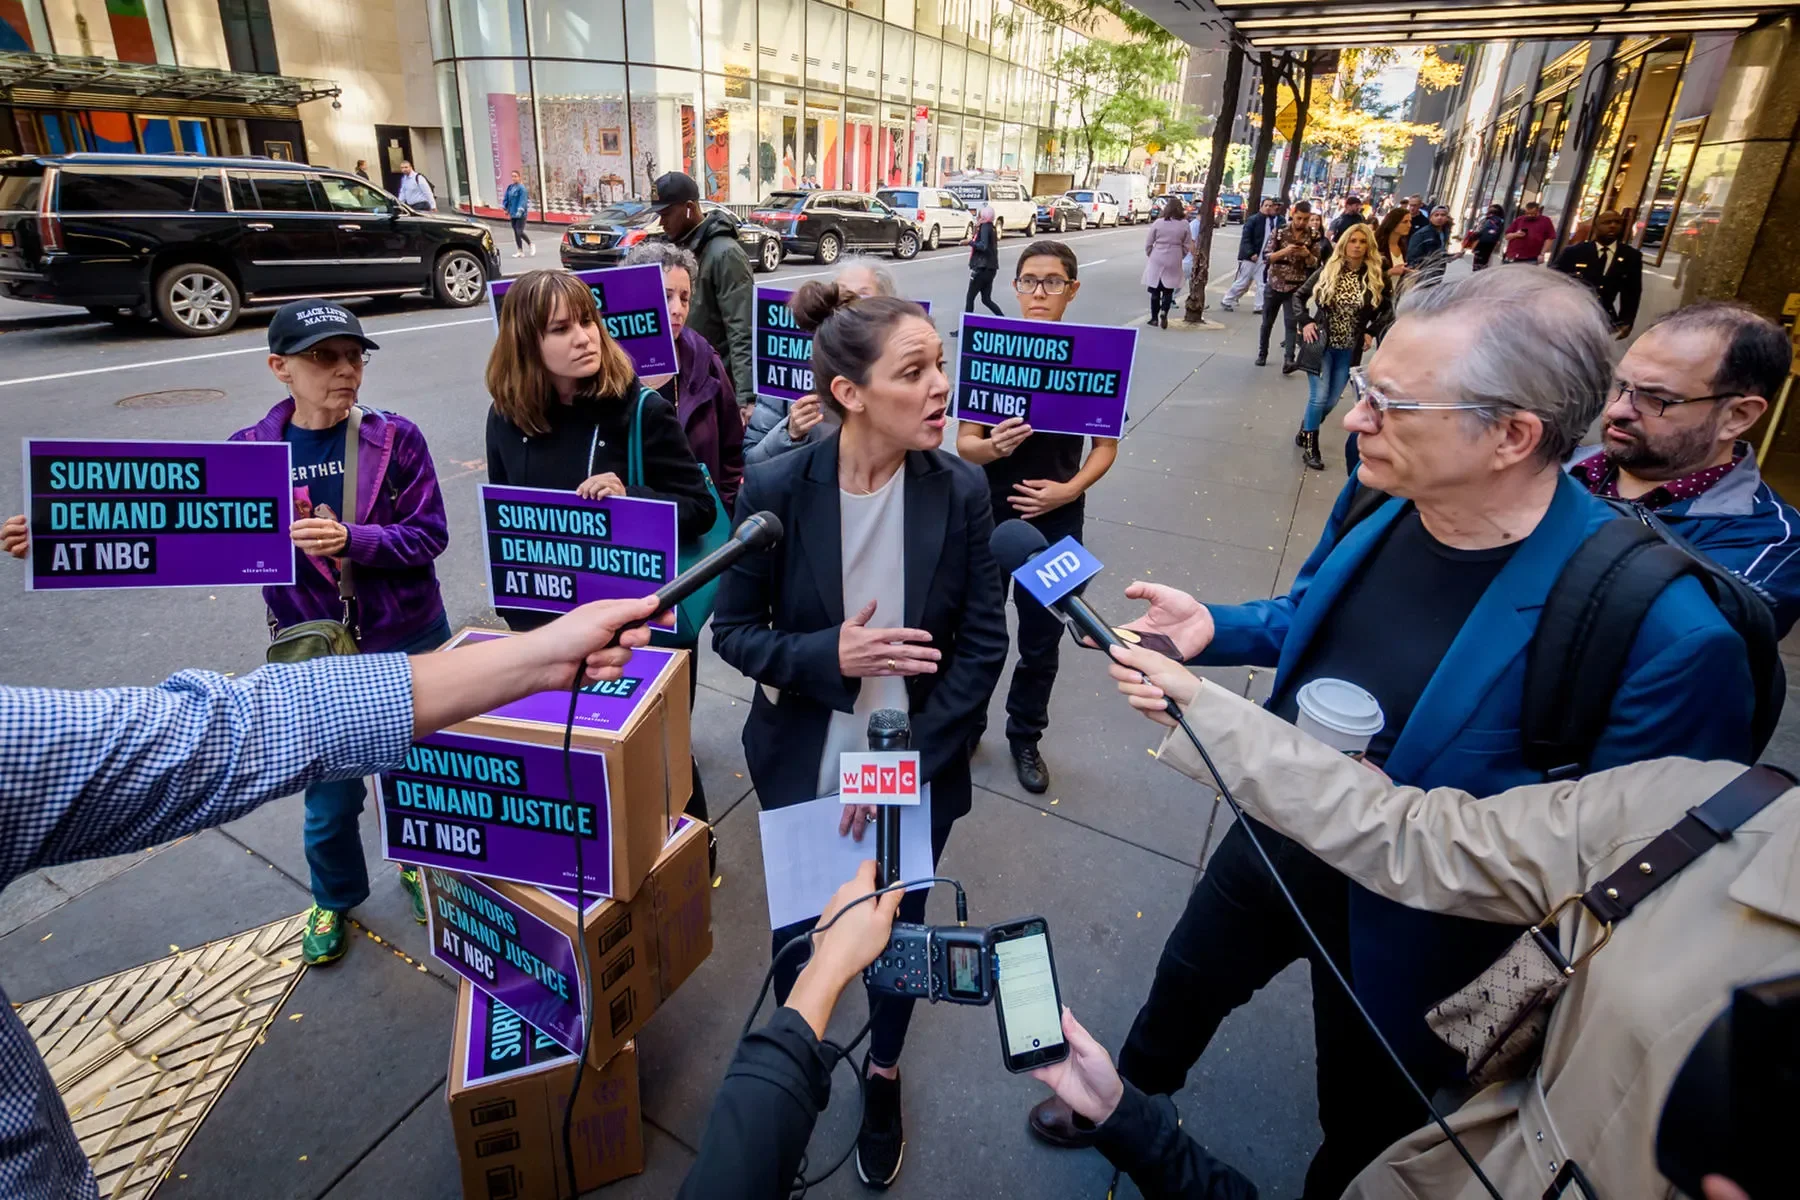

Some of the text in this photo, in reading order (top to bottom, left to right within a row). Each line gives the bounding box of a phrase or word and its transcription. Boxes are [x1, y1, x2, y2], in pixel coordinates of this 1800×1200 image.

[296, 307, 325, 321] BLACK
[303, 315, 348, 327] MATTER
[972, 330, 1069, 361] SURVIVORS
[767, 364, 817, 392] AT NB
[970, 359, 1117, 394] DEMAND JUSTICE
[968, 389, 1027, 417] AT NBC
[50, 461, 200, 490] SURVIVORS
[50, 502, 273, 530] DEMAND JUSTICE
[497, 504, 607, 537] SURVIVORS
[52, 542, 150, 571] AT NBC
[501, 537, 662, 579] DEMAND JUSTICE
[1035, 550, 1081, 589] NTD
[505, 570, 573, 599] AT NBC
[399, 746, 521, 786] URVIVORS
[843, 771, 914, 786] WNYC
[396, 780, 592, 835] DEMAND JUSTICE
[402, 817, 481, 855] AT NBC
[431, 868, 517, 935] SURVIVORS
[437, 896, 569, 999] DEMAND JUSTICE
[443, 927, 495, 980] AT NBC
